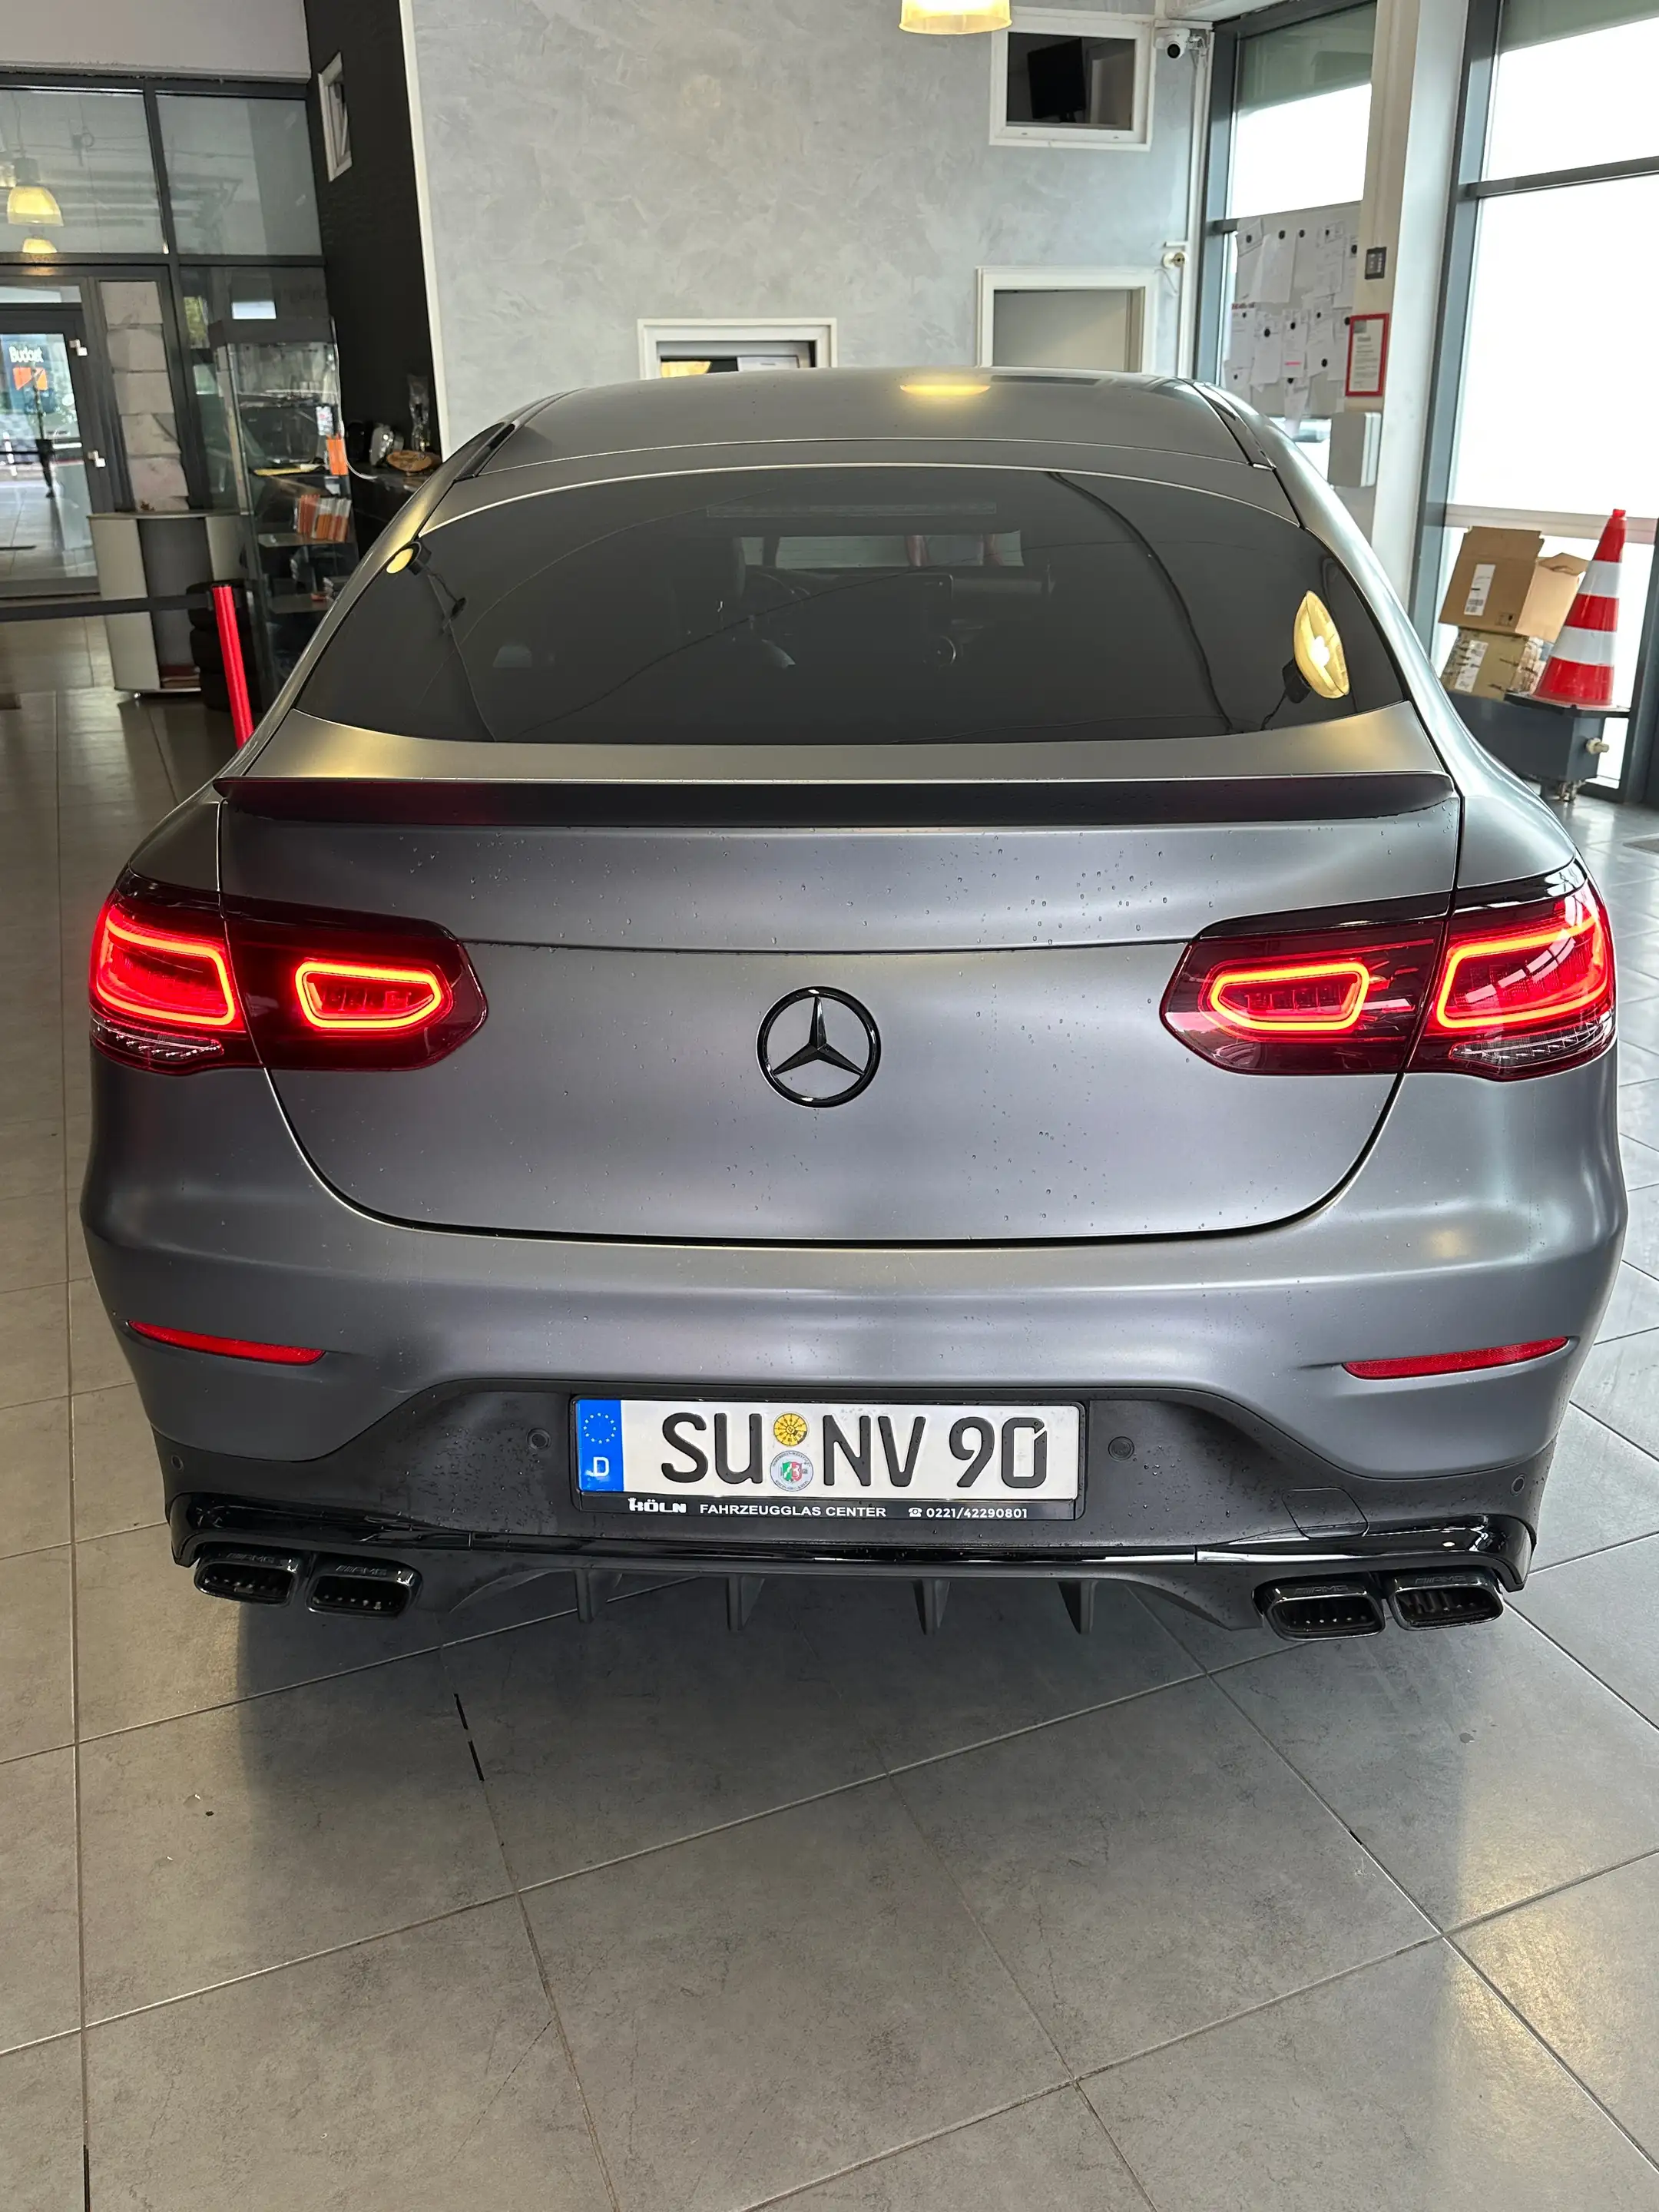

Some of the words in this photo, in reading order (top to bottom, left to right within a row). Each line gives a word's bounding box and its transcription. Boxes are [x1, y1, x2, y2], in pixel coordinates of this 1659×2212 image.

[661, 1412, 763, 1485] SU
[823, 1415, 926, 1488] NV
[949, 1416, 1048, 1488] 90
[593, 1456, 610, 1477] D
[628, 1498, 687, 1514] KÖLN
[700, 1503, 821, 1517] FAHRZEUGGLAS
[825, 1505, 886, 1518] CENTER
[926, 1507, 1028, 1519] 0221/42290801
